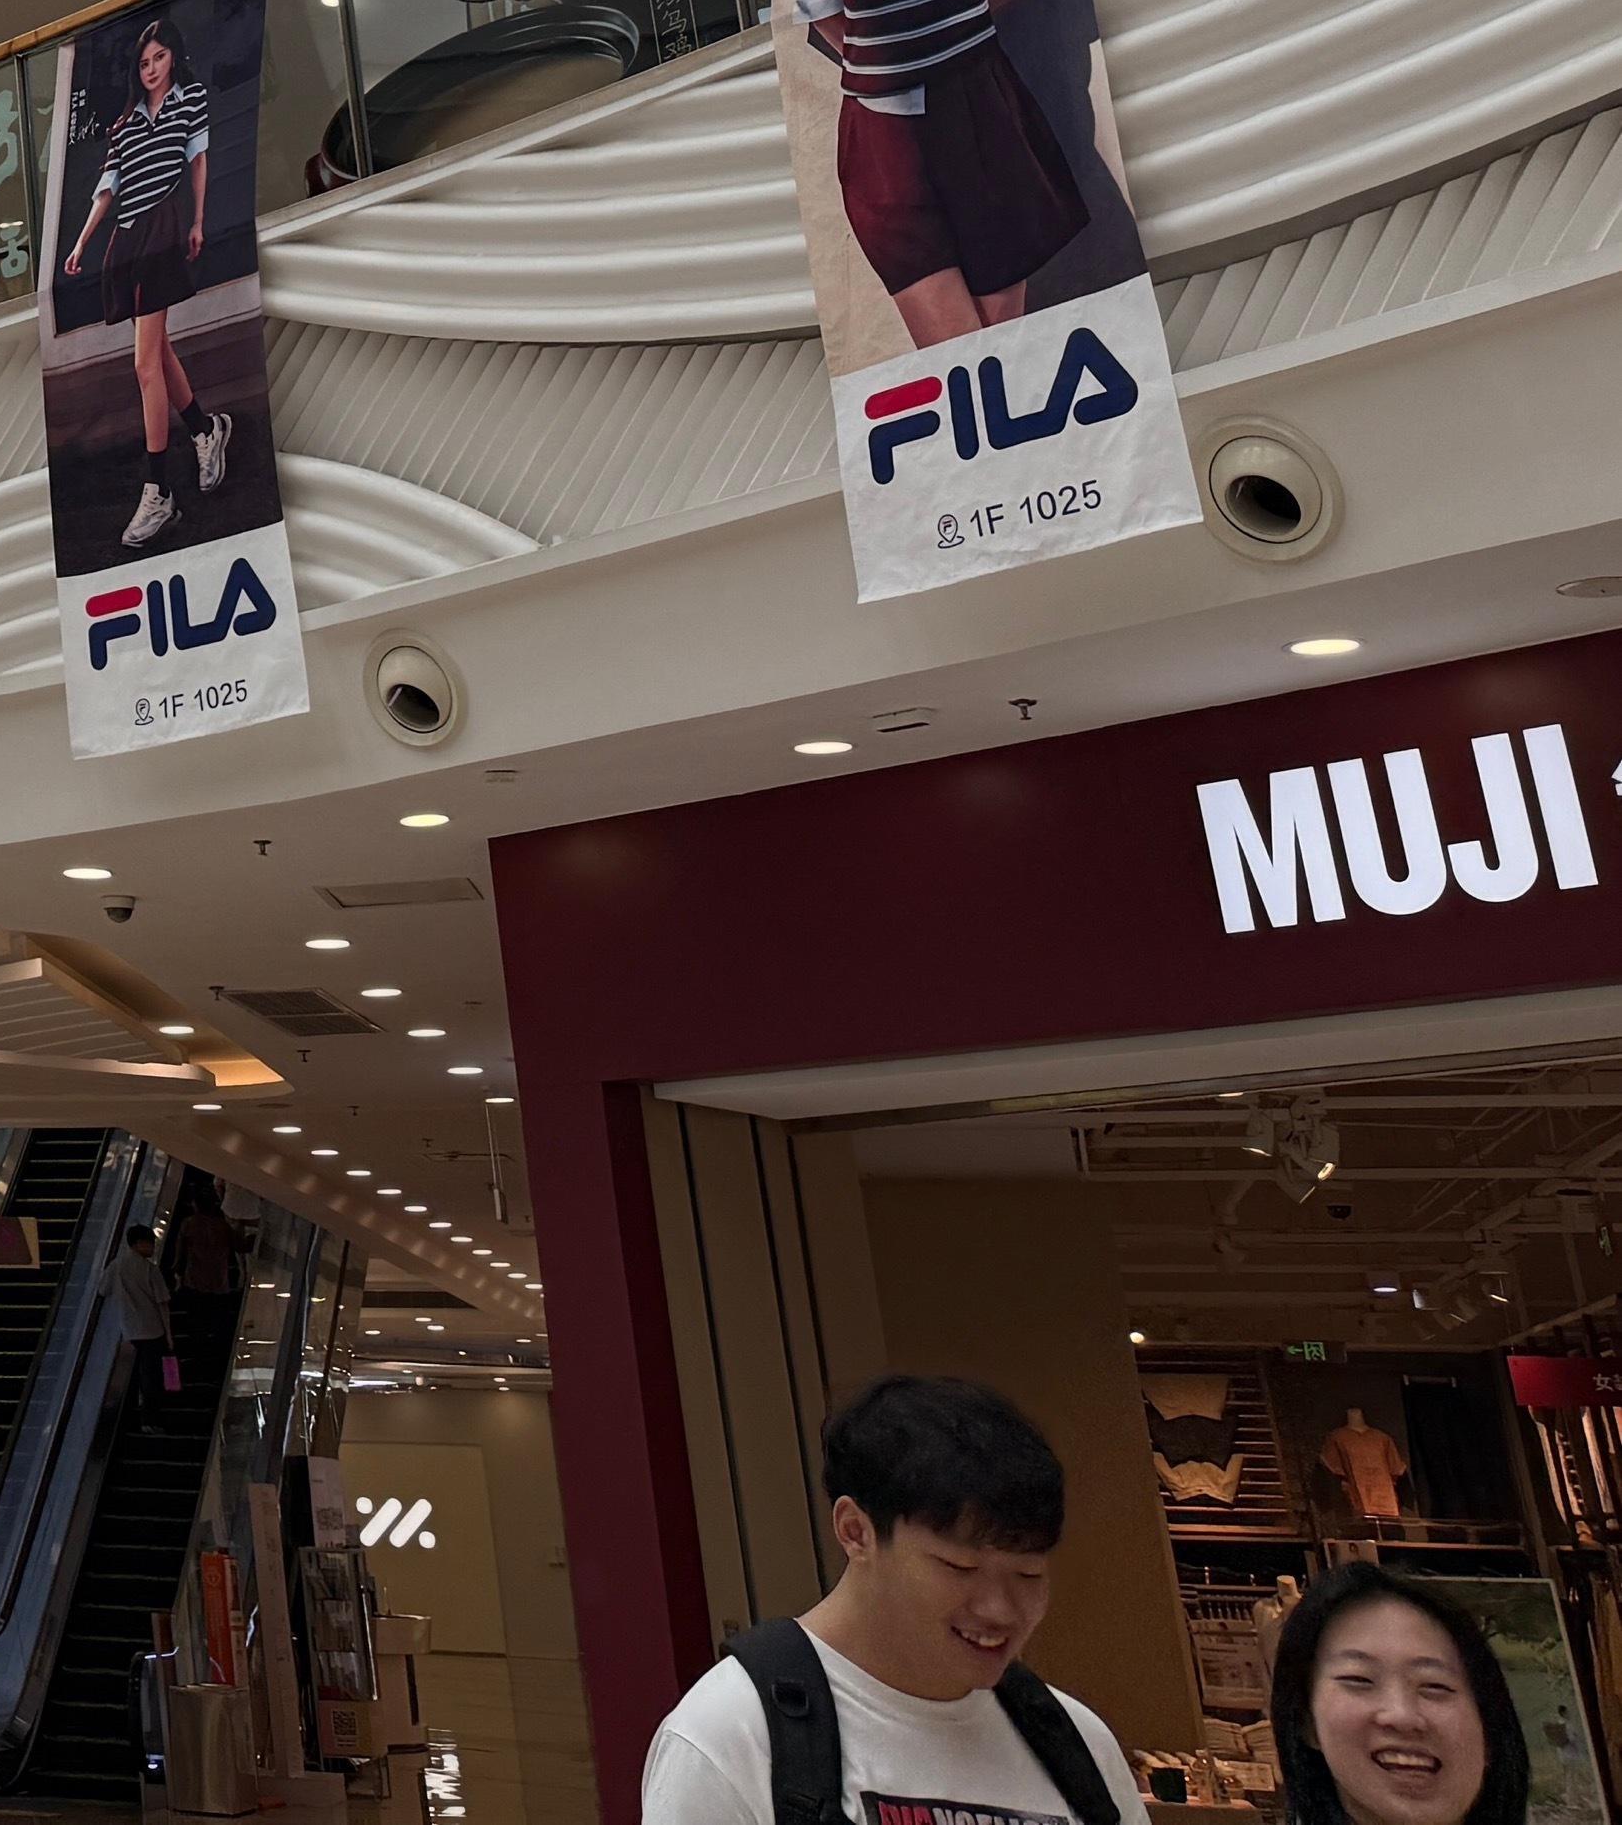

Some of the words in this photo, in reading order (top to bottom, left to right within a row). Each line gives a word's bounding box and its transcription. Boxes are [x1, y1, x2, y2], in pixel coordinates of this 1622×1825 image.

[865, 326, 1138, 486] FILA
[971, 504, 1003, 536] 1F
[1020, 480, 1101, 523] 1025
[85, 556, 276, 670] FILA
[156, 694, 183, 721] 1F
[194, 680, 247, 711] 1025
[1196, 724, 1599, 934] MUJI
